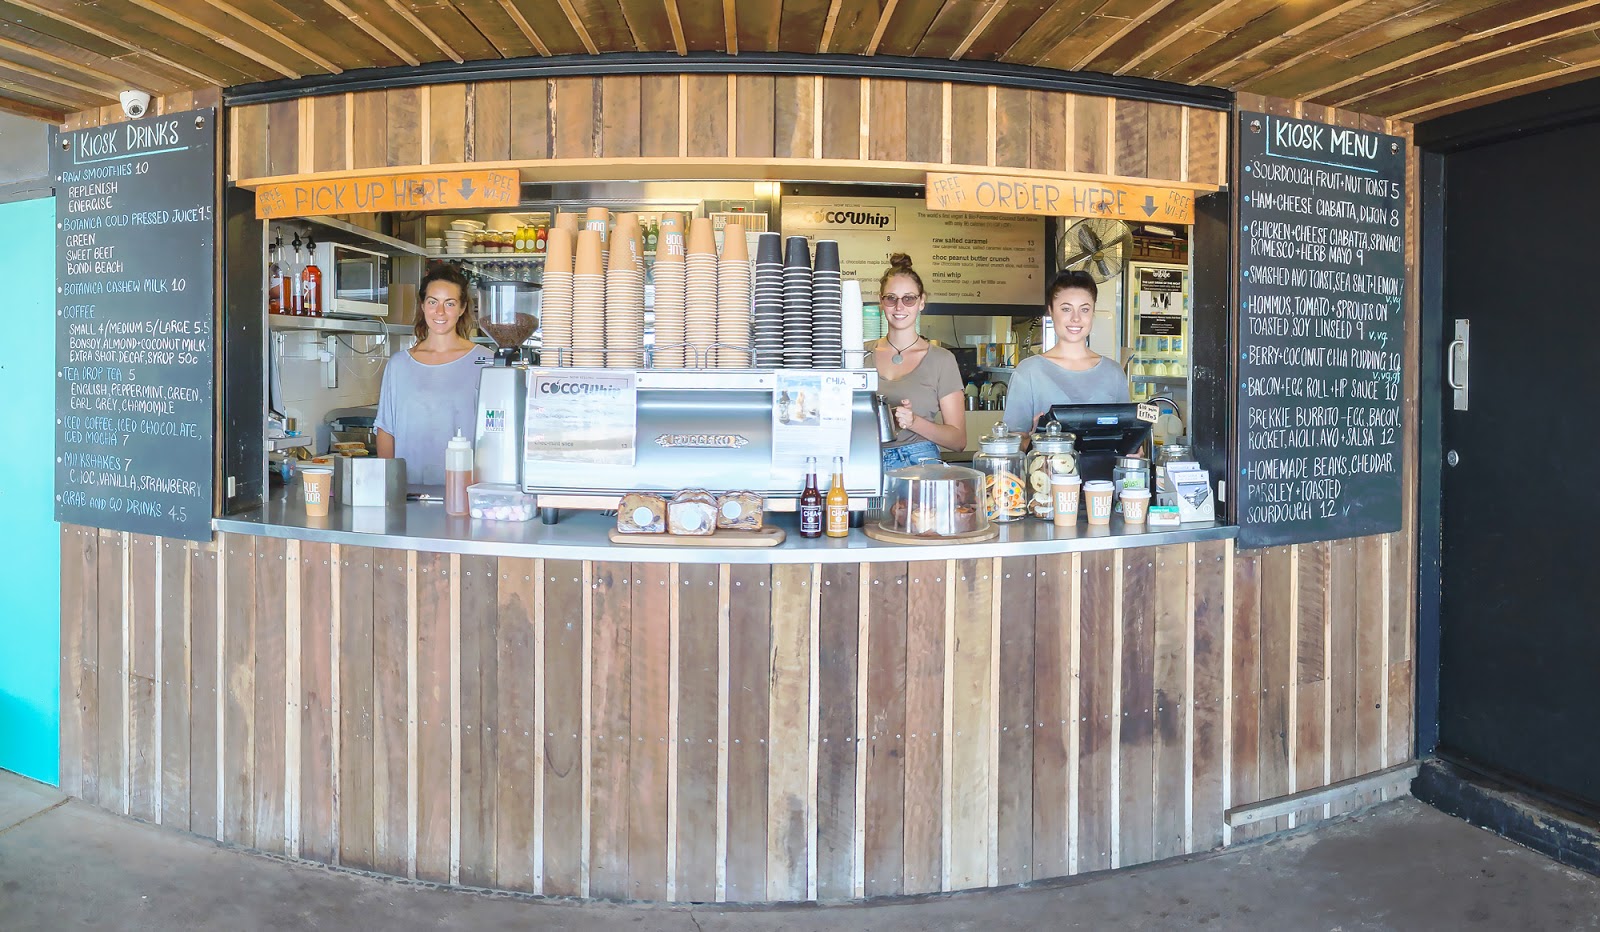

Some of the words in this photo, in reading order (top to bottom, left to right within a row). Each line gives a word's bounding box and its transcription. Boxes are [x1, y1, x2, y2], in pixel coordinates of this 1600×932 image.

[80, 129, 118, 158] KIOSK
[127, 120, 179, 150] DRINKS
[1276, 119, 1323, 151] KIOSK
[1331, 128, 1378, 159] MENU
[62, 171, 81, 184] RAW
[83, 163, 132, 180] SMOOTHIES
[136, 161, 148, 175] 10
[488, 172, 514, 190] FREE
[1253, 161, 1313, 185] SOURDOUGH
[1365, 178, 1388, 197] TOAST
[1391, 183, 1399, 199] 5
[69, 182, 118, 198] REPLENISH
[933, 176, 960, 193] FREE
[259, 186, 281, 203] FREE
[294, 184, 345, 211] PICK
[354, 182, 385, 208] UP
[392, 179, 449, 206] HERE
[976, 181, 1060, 212] ORDER
[1073, 186, 1127, 215] HERE
[1168, 190, 1191, 209] FREE
[69, 196, 113, 212] ENERGISE
[63, 216, 102, 231] BOTANICA
[105, 214, 128, 227] COLD
[132, 209, 169, 225] PRESSED
[172, 208, 198, 222] JUICE
[804, 207, 889, 228] OCOWhip
[1360, 206, 1387, 224] DIJON
[1390, 209, 1399, 226] 8
[66, 234, 96, 247] GREEN
[66, 248, 92, 261] SWEET
[94, 246, 115, 259] BEET
[1329, 249, 1352, 264] MAYO
[1357, 251, 1363, 265] 9
[67, 263, 91, 275] BONDI
[95, 261, 123, 274] BEACH
[1249, 266, 1289, 285] SMASHED
[1292, 269, 1306, 287] AVO
[1335, 272, 1350, 291] SEA
[64, 283, 102, 296] BOTANICA
[107, 281, 140, 293] CASHEW
[144, 279, 168, 293] MILK
[172, 279, 186, 292] 10
[63, 305, 95, 319] COFFEE
[1376, 304, 1387, 321] ON
[69, 323, 96, 335] SMALL
[194, 321, 209, 334] 5.5
[1249, 317, 1288, 335] TOASTED
[1292, 317, 1311, 336] SOY
[1315, 319, 1352, 339] LINSEED
[1356, 321, 1363, 340] 9
[183, 338, 206, 352] MILK
[70, 350, 93, 362] EXTRA
[148, 353, 174, 364] SYRUP
[178, 352, 198, 364] 50c
[1327, 349, 1347, 367] CHIA
[1351, 349, 1386, 370] PUDDING
[1389, 353, 1400, 371] 10
[63, 367, 80, 381] TEA
[82, 367, 103, 380] DROP
[107, 368, 122, 381] TEA
[129, 369, 135, 381] 5
[826, 377, 846, 385] CHIA
[1307, 379, 1329, 398] ROLL
[1351, 380, 1378, 399] SAUCE
[1385, 384, 1397, 400] 10
[71, 398, 92, 409] EARL
[122, 401, 175, 414] CHAMOMILE
[64, 417, 80, 430] ICED
[118, 419, 137, 432] ICED
[1249, 407, 1290, 429] BREKKIE
[1296, 407, 1339, 426] BURRITO
[64, 432, 82, 444] ICED
[85, 433, 117, 446] MOCHA
[123, 434, 129, 446] 7
[1320, 428, 1339, 447] AVO
[1380, 428, 1394, 445] 12
[124, 458, 132, 471] 7
[1249, 457, 1308, 480] HOMEMADE
[1059, 491, 1077, 501] BLUE
[1249, 483, 1294, 502] PARSLEY
[63, 491, 86, 506] GRAB
[90, 497, 106, 509] AND
[110, 498, 122, 510] GO
[127, 499, 162, 517] DRINKS
[168, 506, 186, 523] 4.5
[1094, 507, 1110, 516] DOO
[1126, 502, 1141, 511] BLUE
[1247, 503, 1311, 523] SOURDOUGH
[1320, 500, 1337, 519] 12
